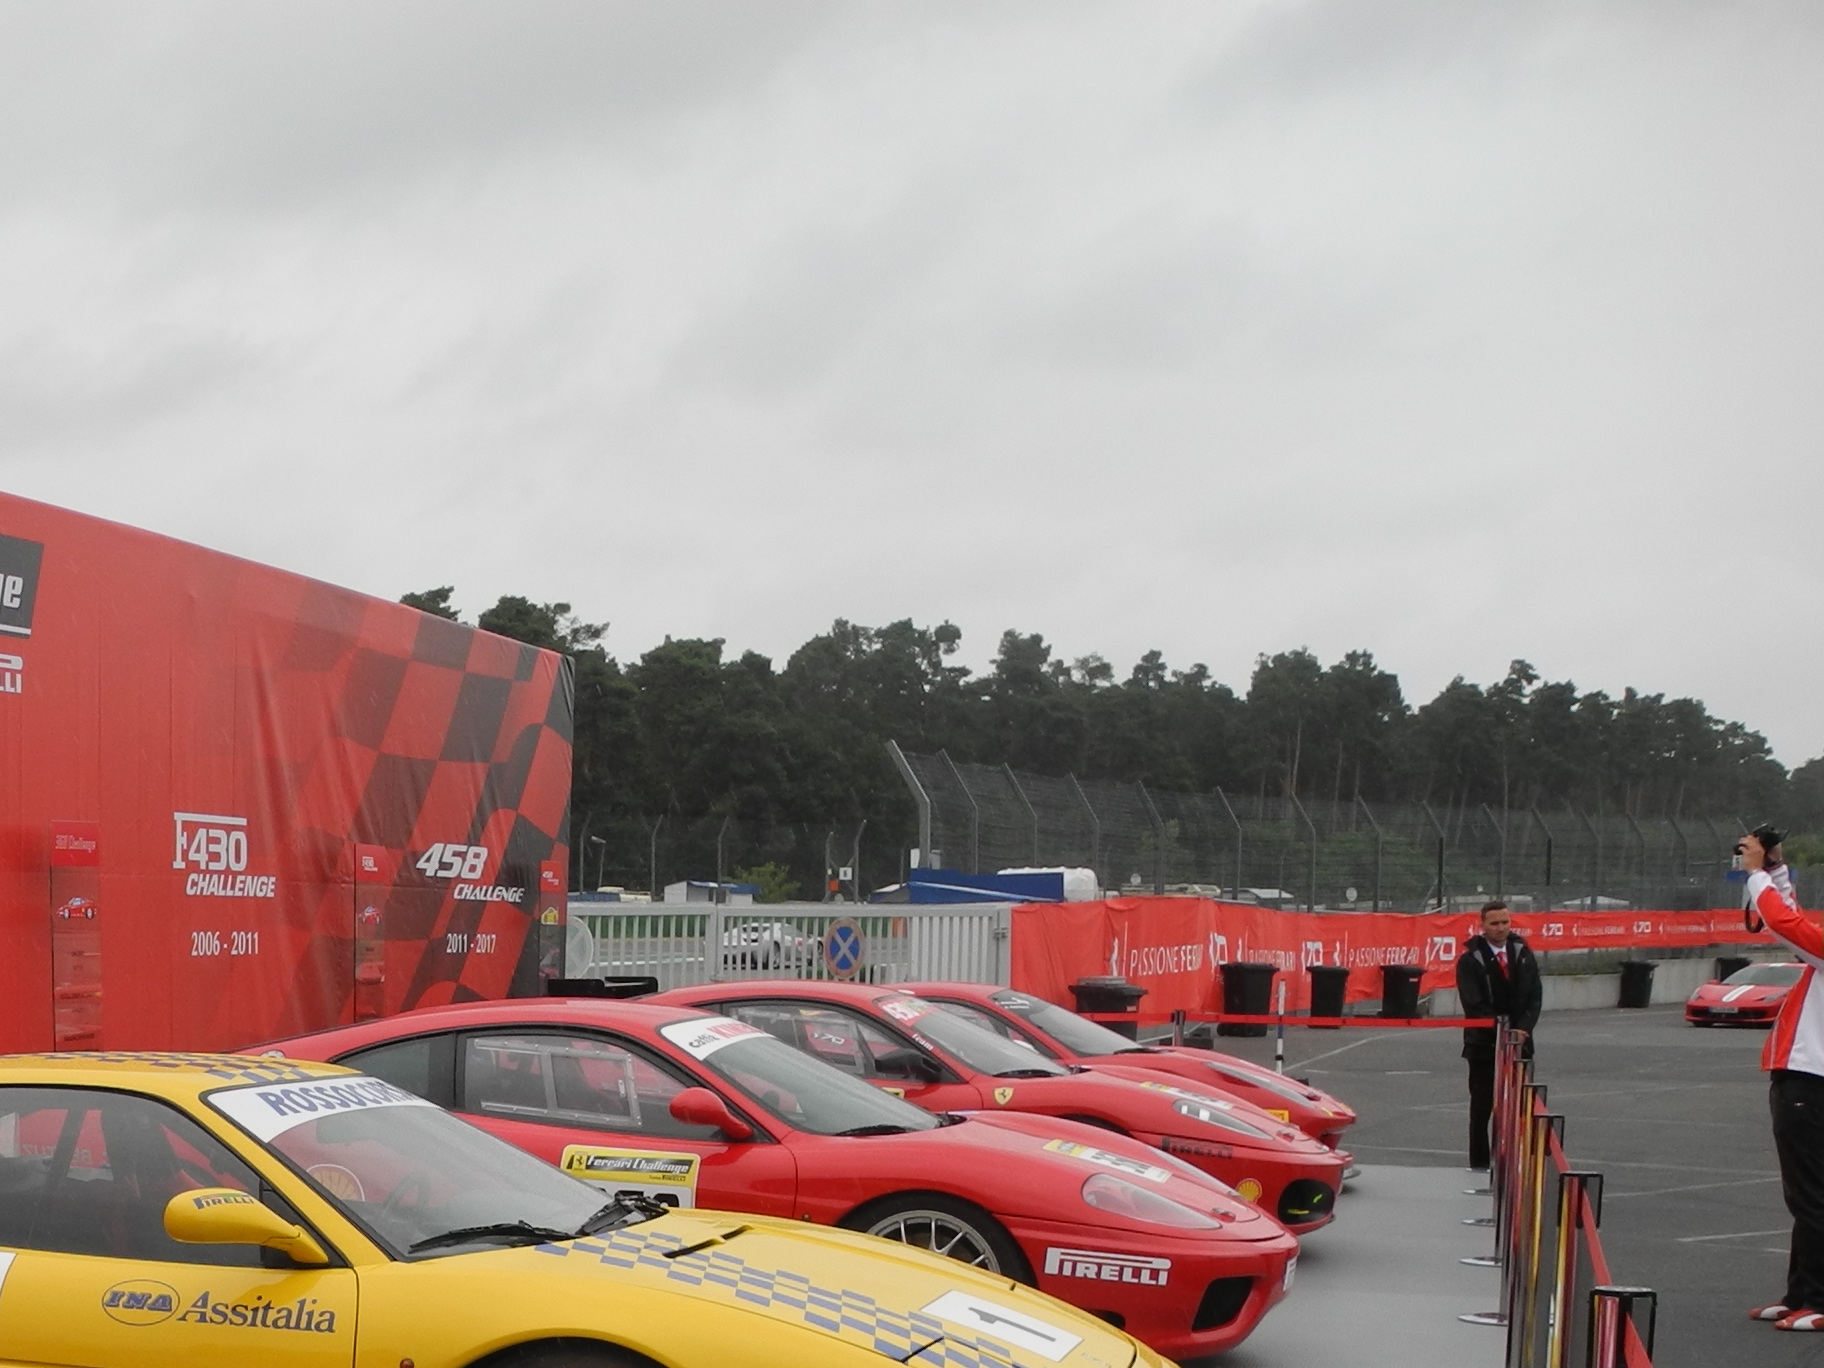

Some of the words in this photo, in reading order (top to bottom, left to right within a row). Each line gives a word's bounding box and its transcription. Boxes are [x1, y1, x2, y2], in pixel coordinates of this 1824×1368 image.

[173, 812, 248, 871] F430
[416, 843, 488, 879] 458
[185, 872, 277, 899] CHALLENGE
[453, 883, 526, 904] CHALLENGE
[1549, 923, 1564, 936] 70
[1636, 921, 1652, 933] 70
[190, 931, 221, 957] 2006
[231, 931, 260, 956] 2011
[446, 933, 469, 954] 2011
[475, 933, 497, 954] 2017
[1429, 936, 1457, 961] 70
[586, 1153, 631, 1169] Ferrari
[633, 1158, 690, 1174] Challenge
[1044, 1247, 1172, 1286] PIRELLI
[103, 1288, 175, 1314] INA
[176, 1290, 336, 1334] Assitalia
